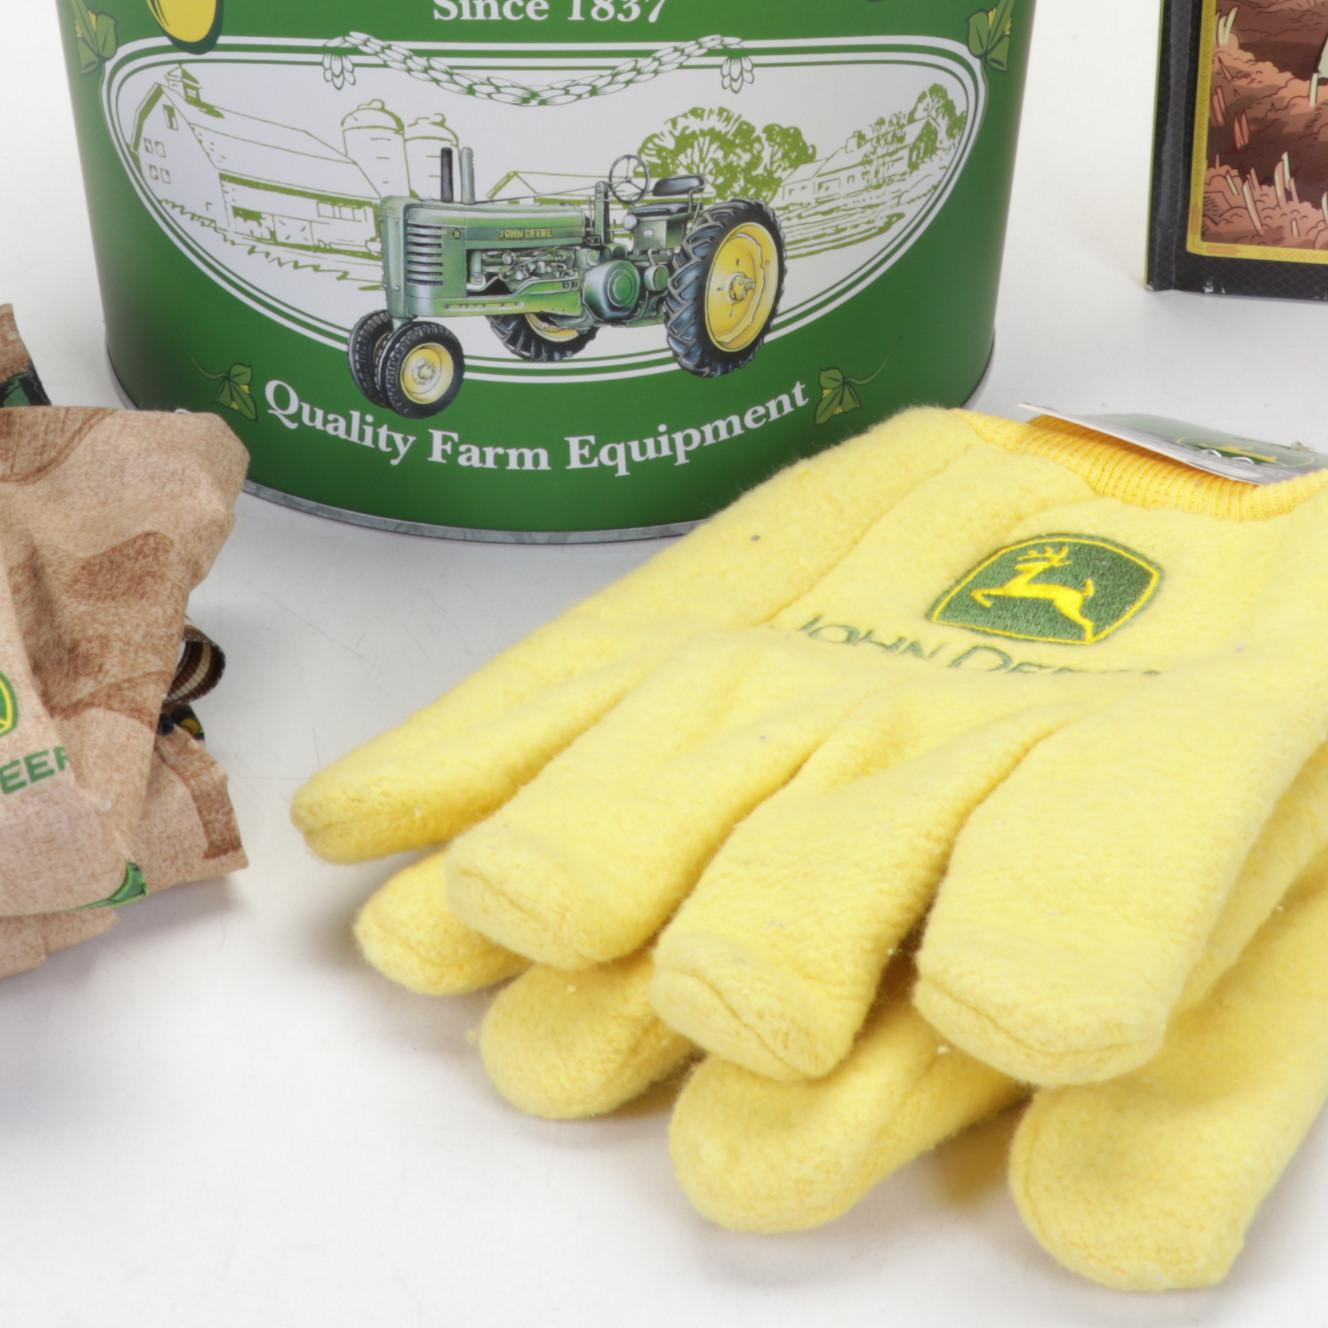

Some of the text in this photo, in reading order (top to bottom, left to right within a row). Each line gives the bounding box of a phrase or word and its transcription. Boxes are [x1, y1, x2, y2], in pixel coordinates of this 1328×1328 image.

[264, 377, 808, 476] Quality Farm Equipment
